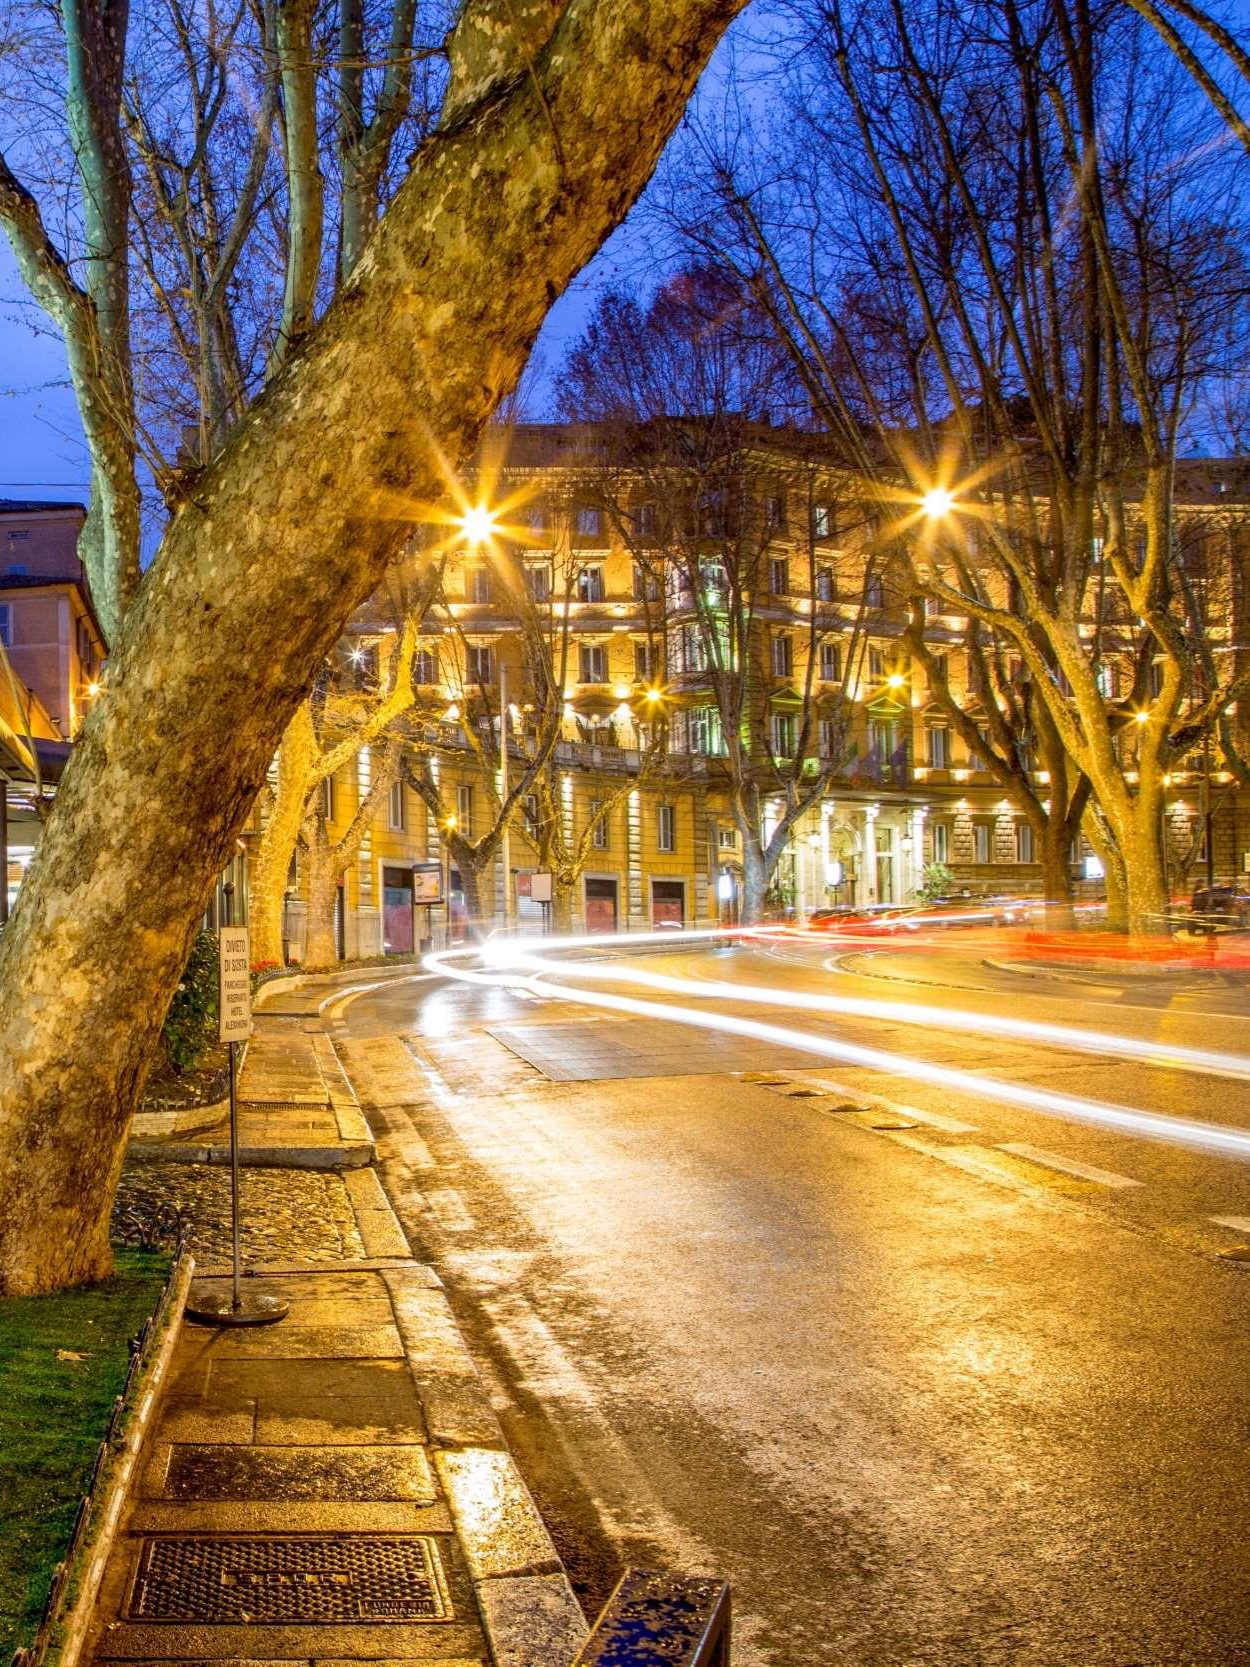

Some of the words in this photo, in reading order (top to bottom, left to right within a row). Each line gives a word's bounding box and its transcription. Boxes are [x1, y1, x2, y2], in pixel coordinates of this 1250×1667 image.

[226, 940, 245, 953] DIVIETO
[224, 959, 231, 973] DI
[232, 959, 247, 972] SOSTA
[230, 1006, 243, 1017] HOTEL
